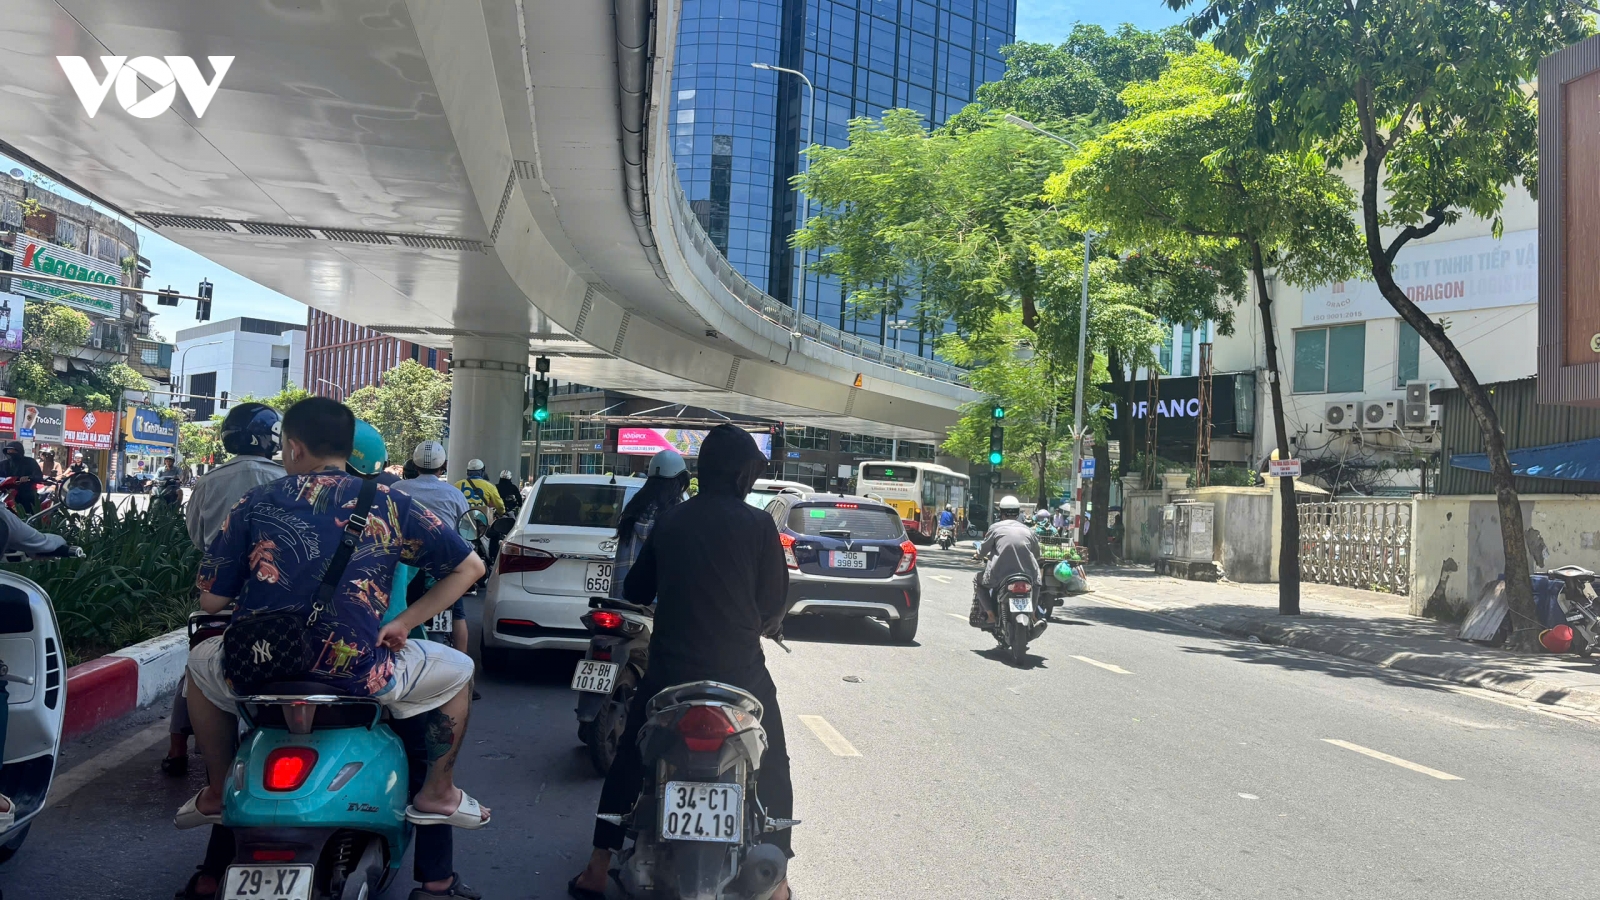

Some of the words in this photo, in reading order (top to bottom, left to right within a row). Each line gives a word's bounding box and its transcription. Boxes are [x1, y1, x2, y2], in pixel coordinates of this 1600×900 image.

[1413, 261, 1430, 278] TY
[1434, 254, 1474, 275] TNHH
[1477, 245, 1511, 271] TIẾP
[1406, 281, 1465, 303] DRAGON
[251, 639, 273, 664] NY
[580, 662, 612, 678] 29-BH
[576, 675, 612, 692] 101.82
[676, 787, 728, 811] 34-C1
[668, 812, 735, 838] 024.19
[236, 869, 300, 895] 29-X7
